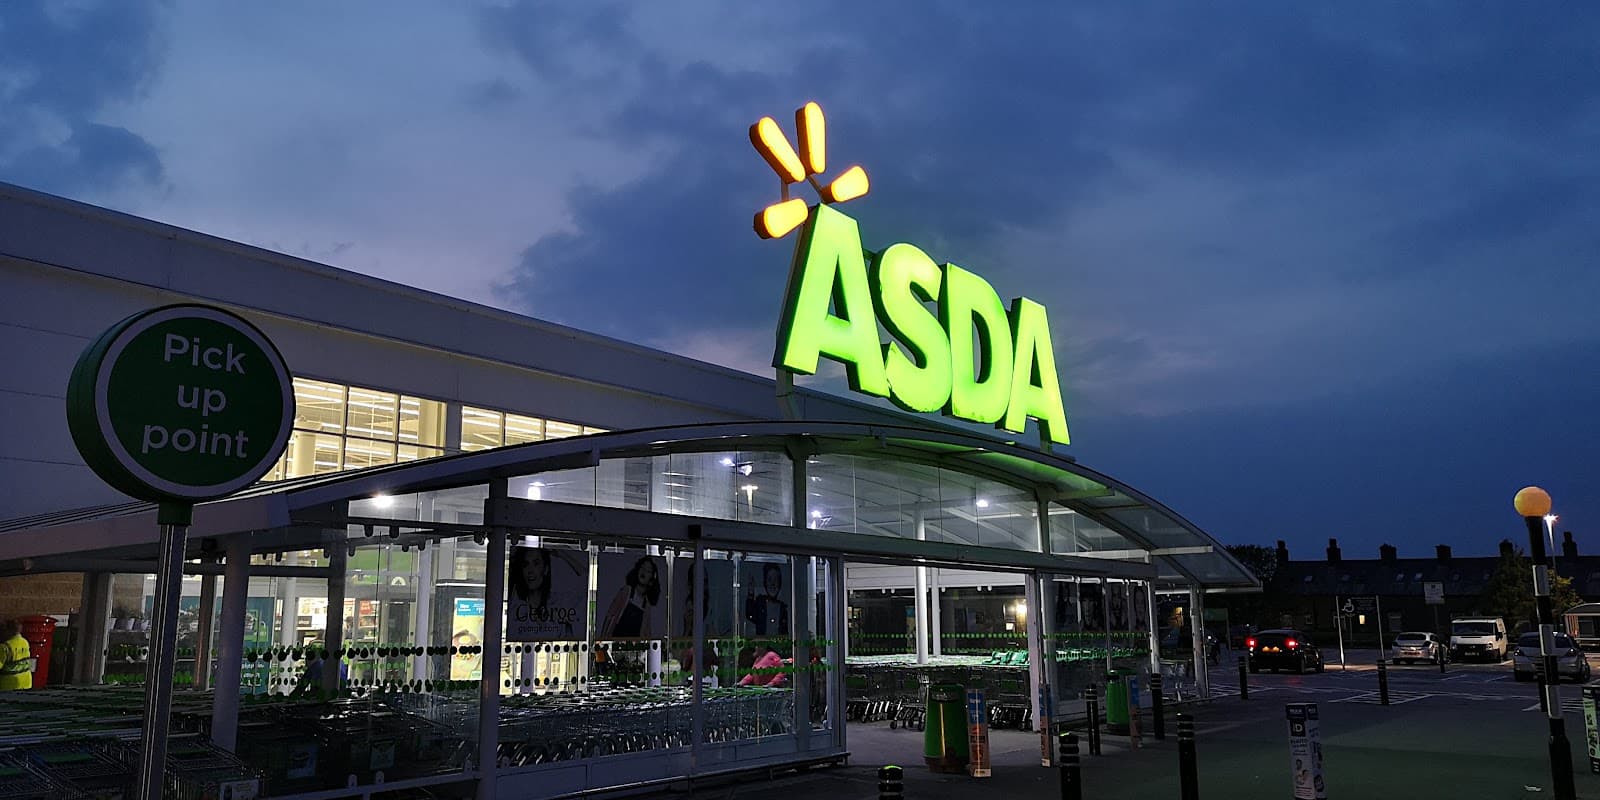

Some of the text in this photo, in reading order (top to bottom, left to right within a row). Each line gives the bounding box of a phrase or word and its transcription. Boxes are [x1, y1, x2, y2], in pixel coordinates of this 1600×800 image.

[779, 203, 1070, 445] ASDA
[163, 333, 247, 375] Pick
[177, 384, 227, 417] up
[141, 423, 249, 459] point
